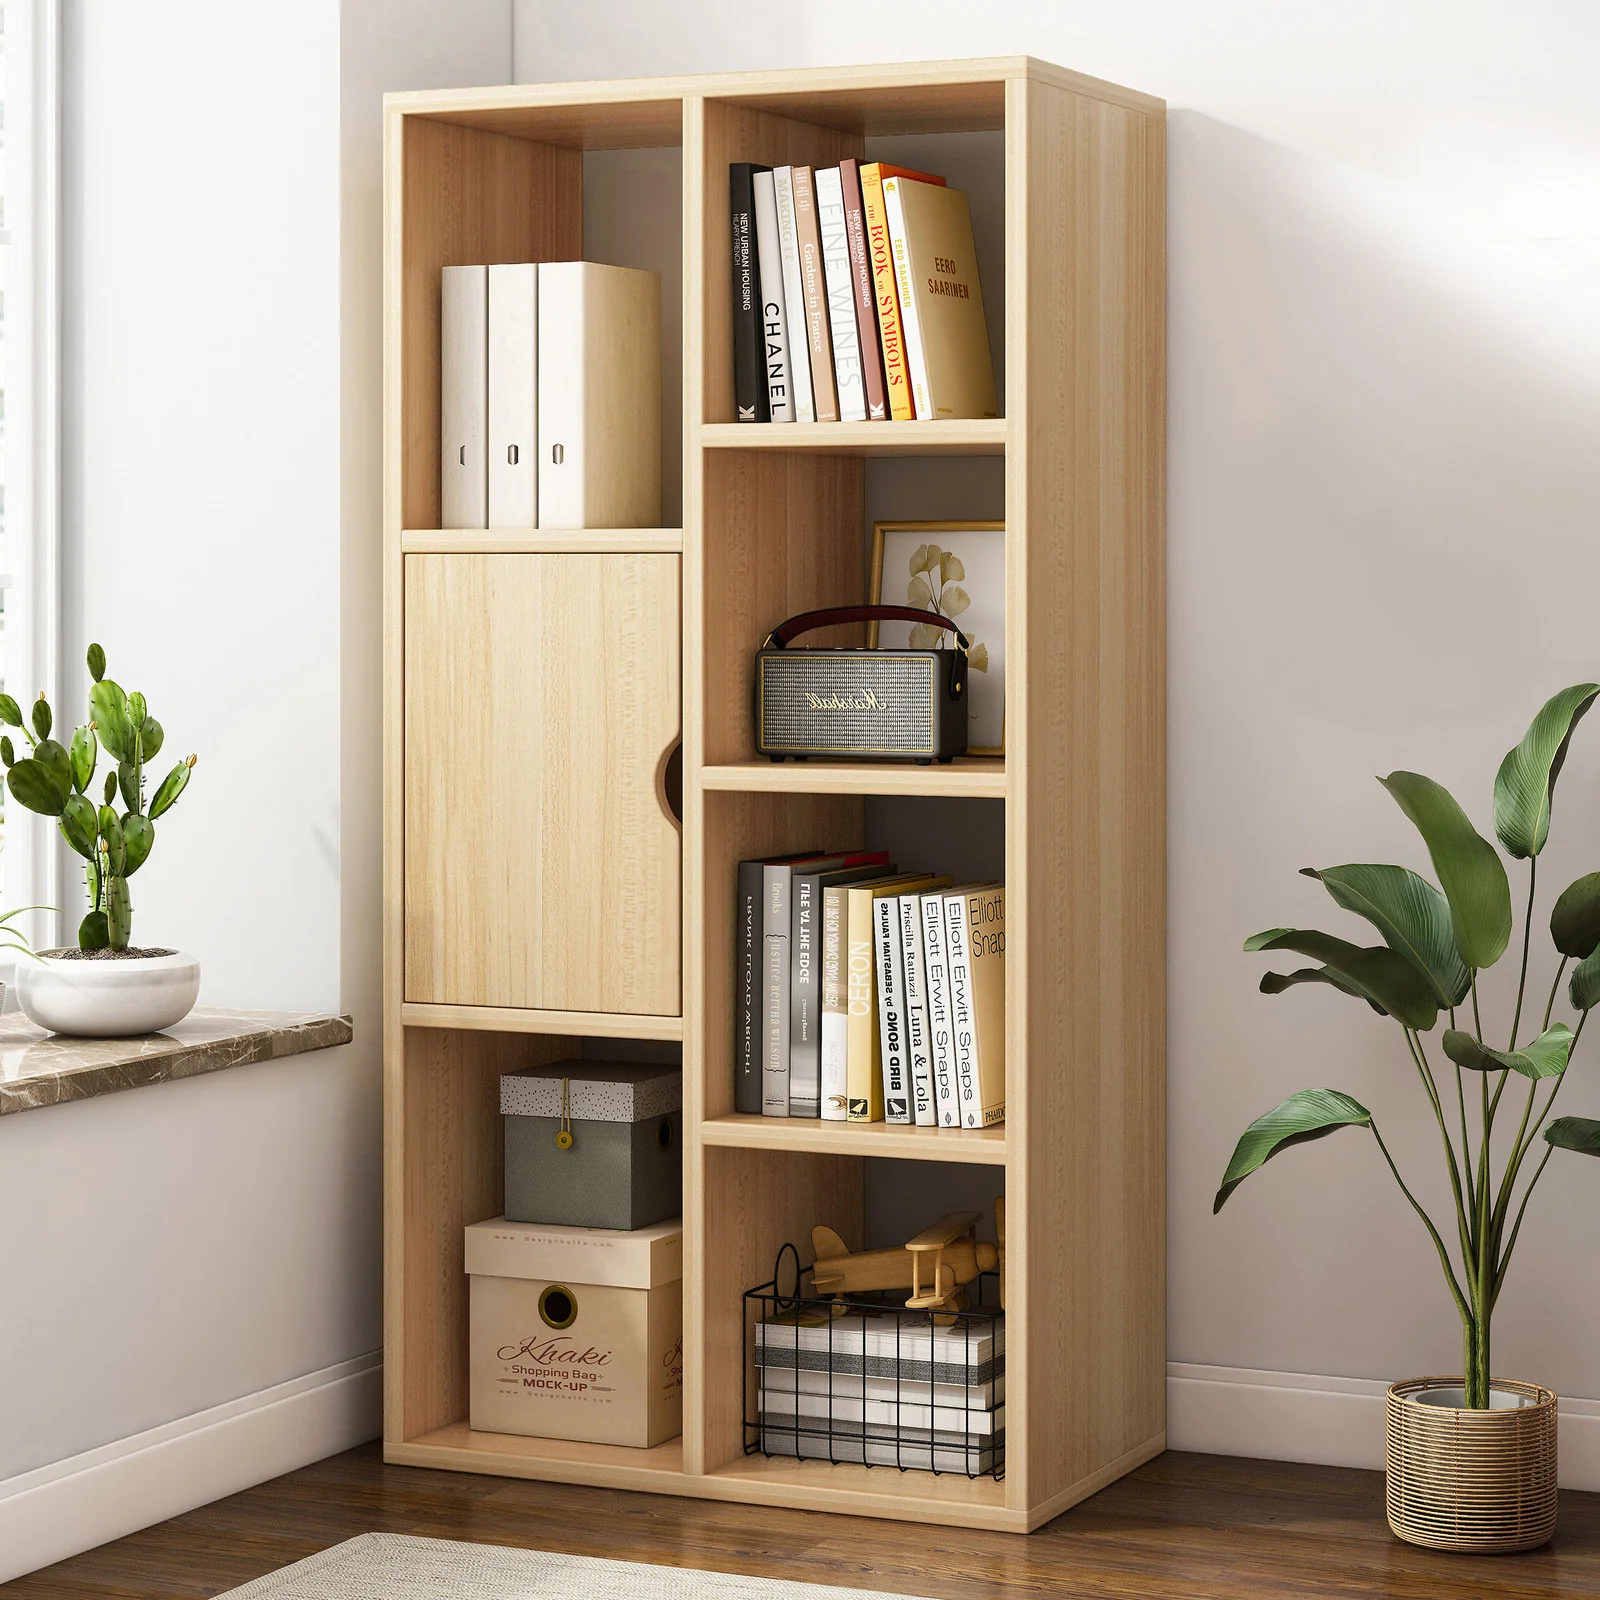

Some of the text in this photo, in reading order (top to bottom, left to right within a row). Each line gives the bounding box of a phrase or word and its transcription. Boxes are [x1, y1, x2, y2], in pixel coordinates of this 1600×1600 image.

[777, 180, 792, 242] MAKING
[820, 203, 842, 271] FINE
[740, 213, 751, 310] NEW URBAN HOUSING
[784, 245, 794, 261] IT
[852, 209, 870, 307] NEW URBAN HOUSING
[871, 225, 888, 276] BOOK
[895, 239, 911, 308] EERO SAARINEN
[935, 258, 956, 274] EERO
[804, 244, 821, 352] Gardens in France
[879, 281, 884, 292] OF
[928, 279, 969, 300] SAARINEN
[764, 303, 786, 416] CHANEL
[830, 283, 860, 387] WINES
[880, 296, 902, 386] SYMBOLS
[772, 883, 783, 913] Brooks
[971, 896, 1004, 926] Elliott
[850, 941, 870, 1015] CERON
[903, 903, 918, 997] Priscilla Rattazzi
[973, 931, 1005, 958] Snap
[926, 902, 950, 1099] Elliott Erwitt Snaps
[949, 903, 972, 1101] Elliott Erwitt Snaps
[910, 1005, 929, 1112] Luna & Lola
[497, 1336, 613, 1366] Khaki
[512, 1365, 597, 1381] Shopping Bag
[524, 1378, 588, 1391] MOCK-UP
